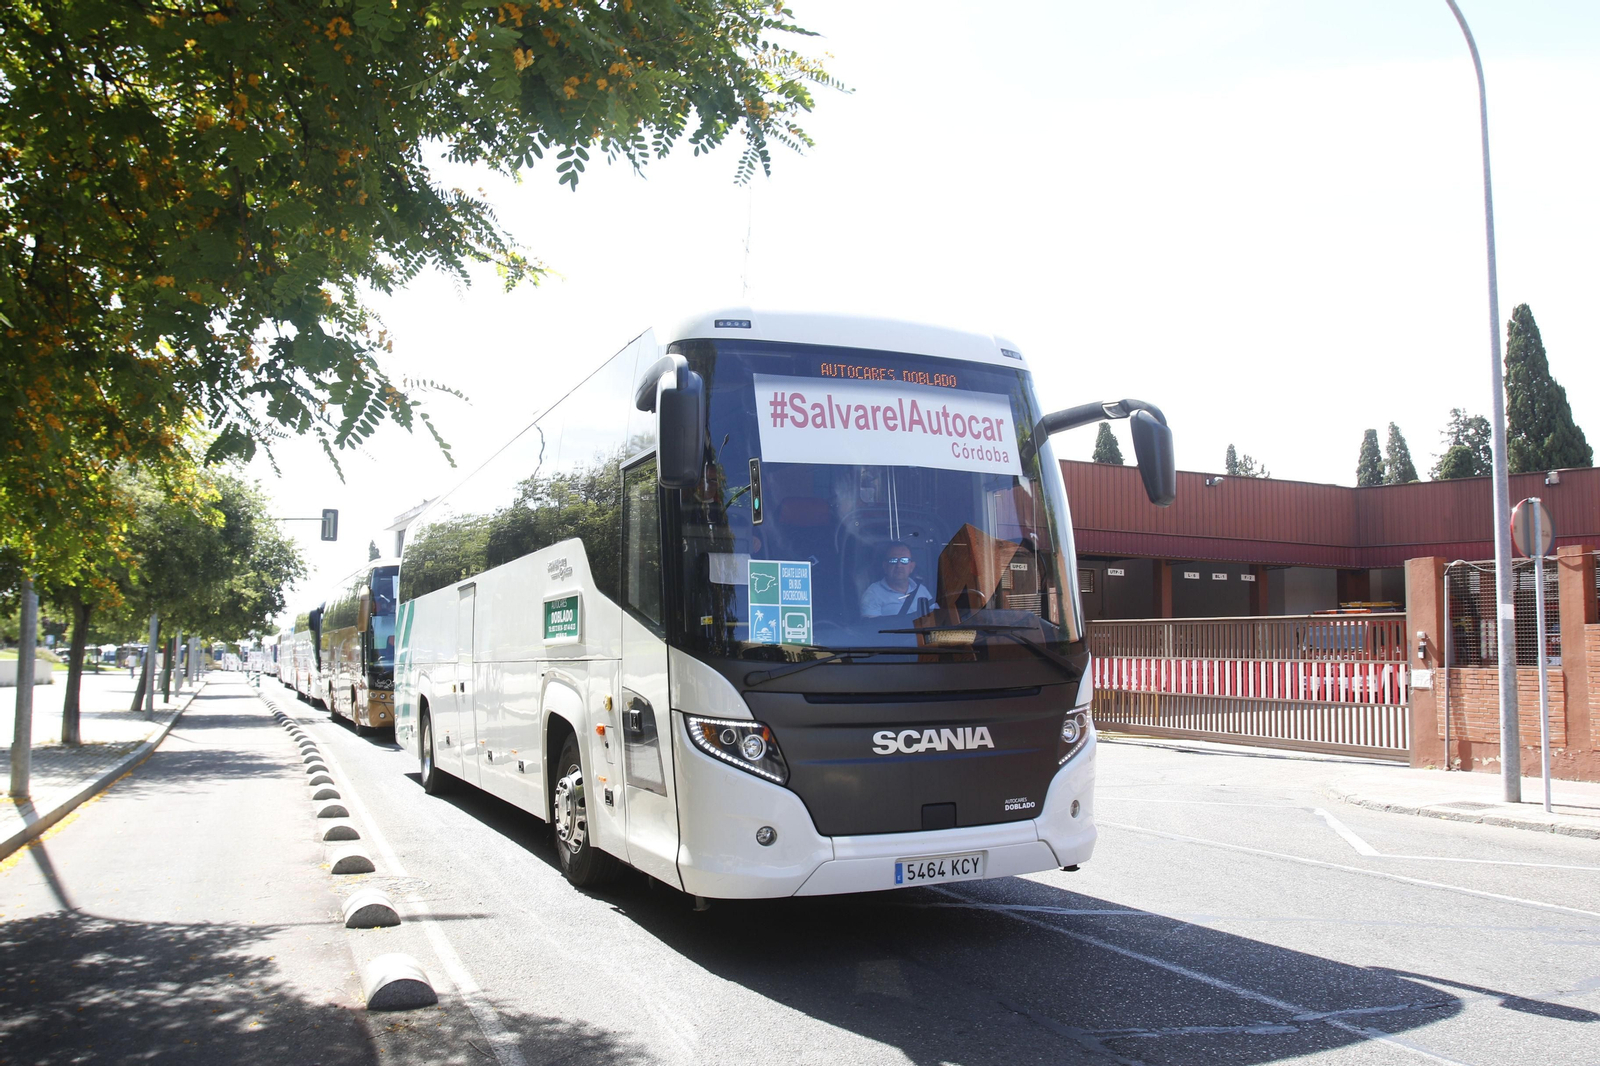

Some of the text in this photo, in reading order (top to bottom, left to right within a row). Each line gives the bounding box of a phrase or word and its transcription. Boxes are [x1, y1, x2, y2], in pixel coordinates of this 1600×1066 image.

[821, 362, 957, 388] AUTOCARES DOBLADO
[769, 391, 1004, 442] #SalvarelAutocar
[951, 441, 1010, 463] Córdoba
[551, 609, 573, 624] DOBLADO
[872, 726, 995, 755] SCANIA
[1004, 797, 1028, 805] AUTOCARES
[1004, 801, 1036, 812] DOBLADO
[907, 857, 980, 881] 5464 KCY
